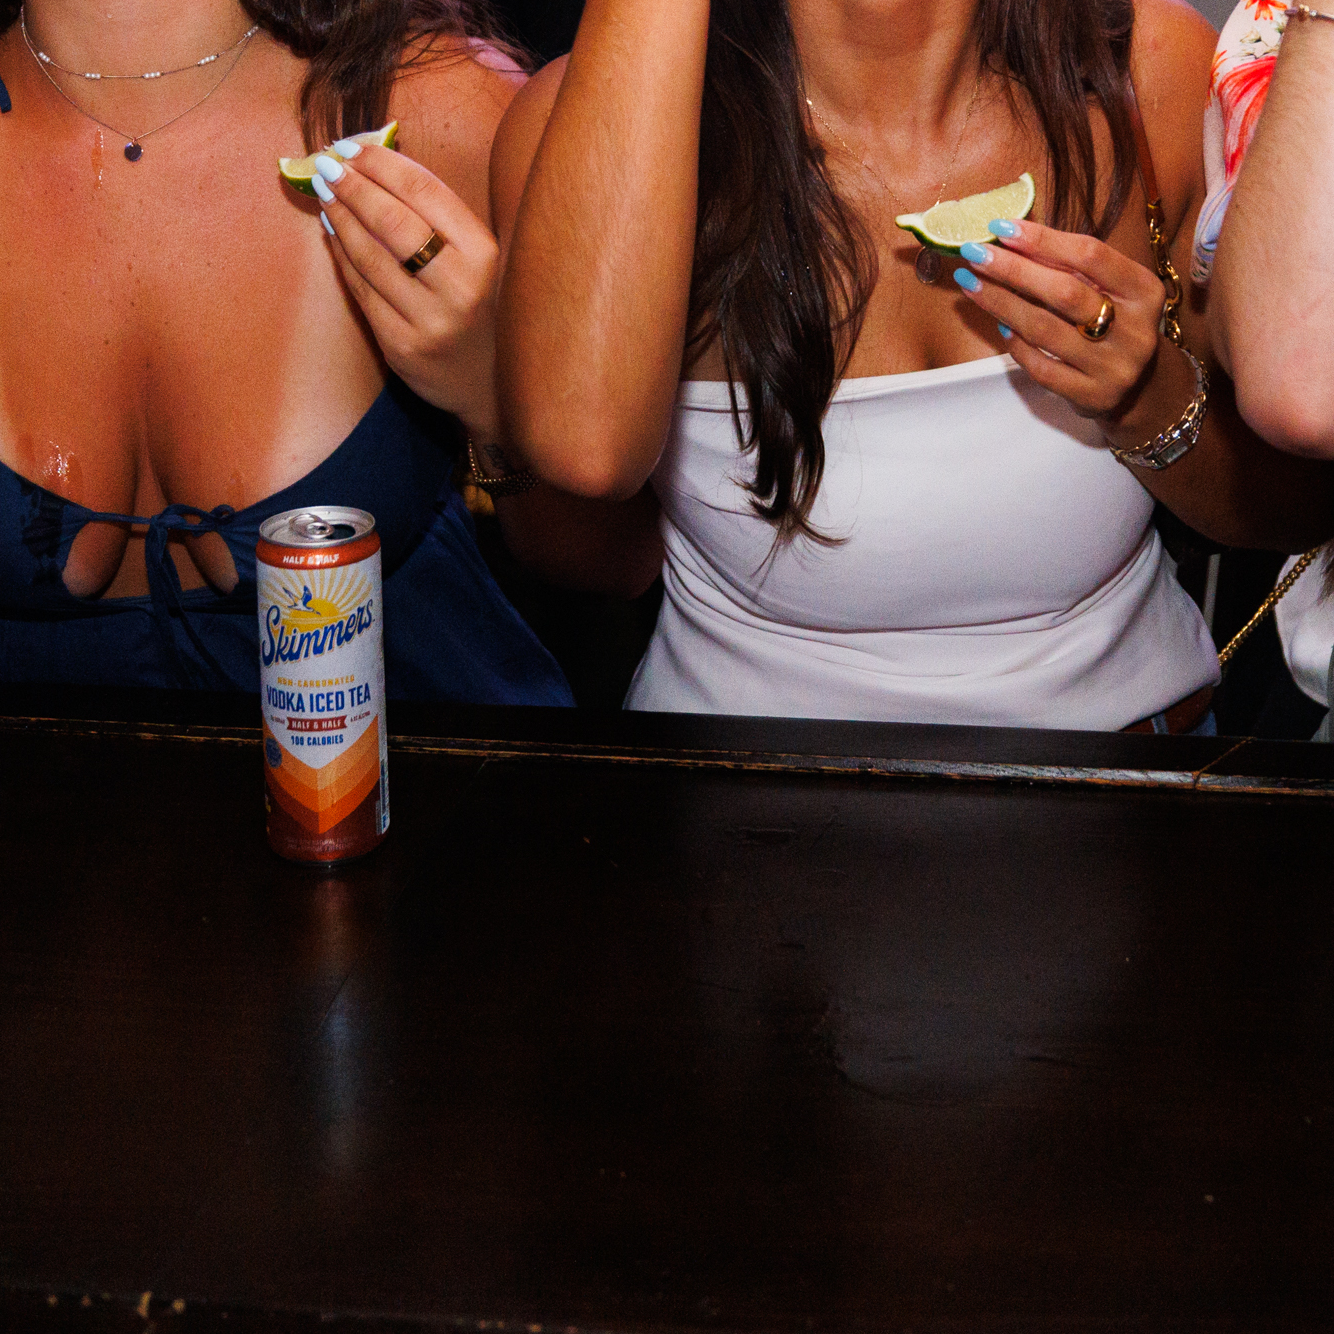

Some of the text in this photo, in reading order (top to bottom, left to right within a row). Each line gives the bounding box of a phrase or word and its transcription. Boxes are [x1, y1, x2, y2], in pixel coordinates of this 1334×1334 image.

[283, 554, 305, 564] HALF
[261, 599, 375, 667] Skimmers
[277, 674, 355, 688] NON-CARBONATED
[266, 682, 371, 714] VODKA ICED TEA
[291, 719, 310, 729] HALF
[321, 718, 342, 729] HALF
[290, 733, 344, 746] 100 CALORIES
